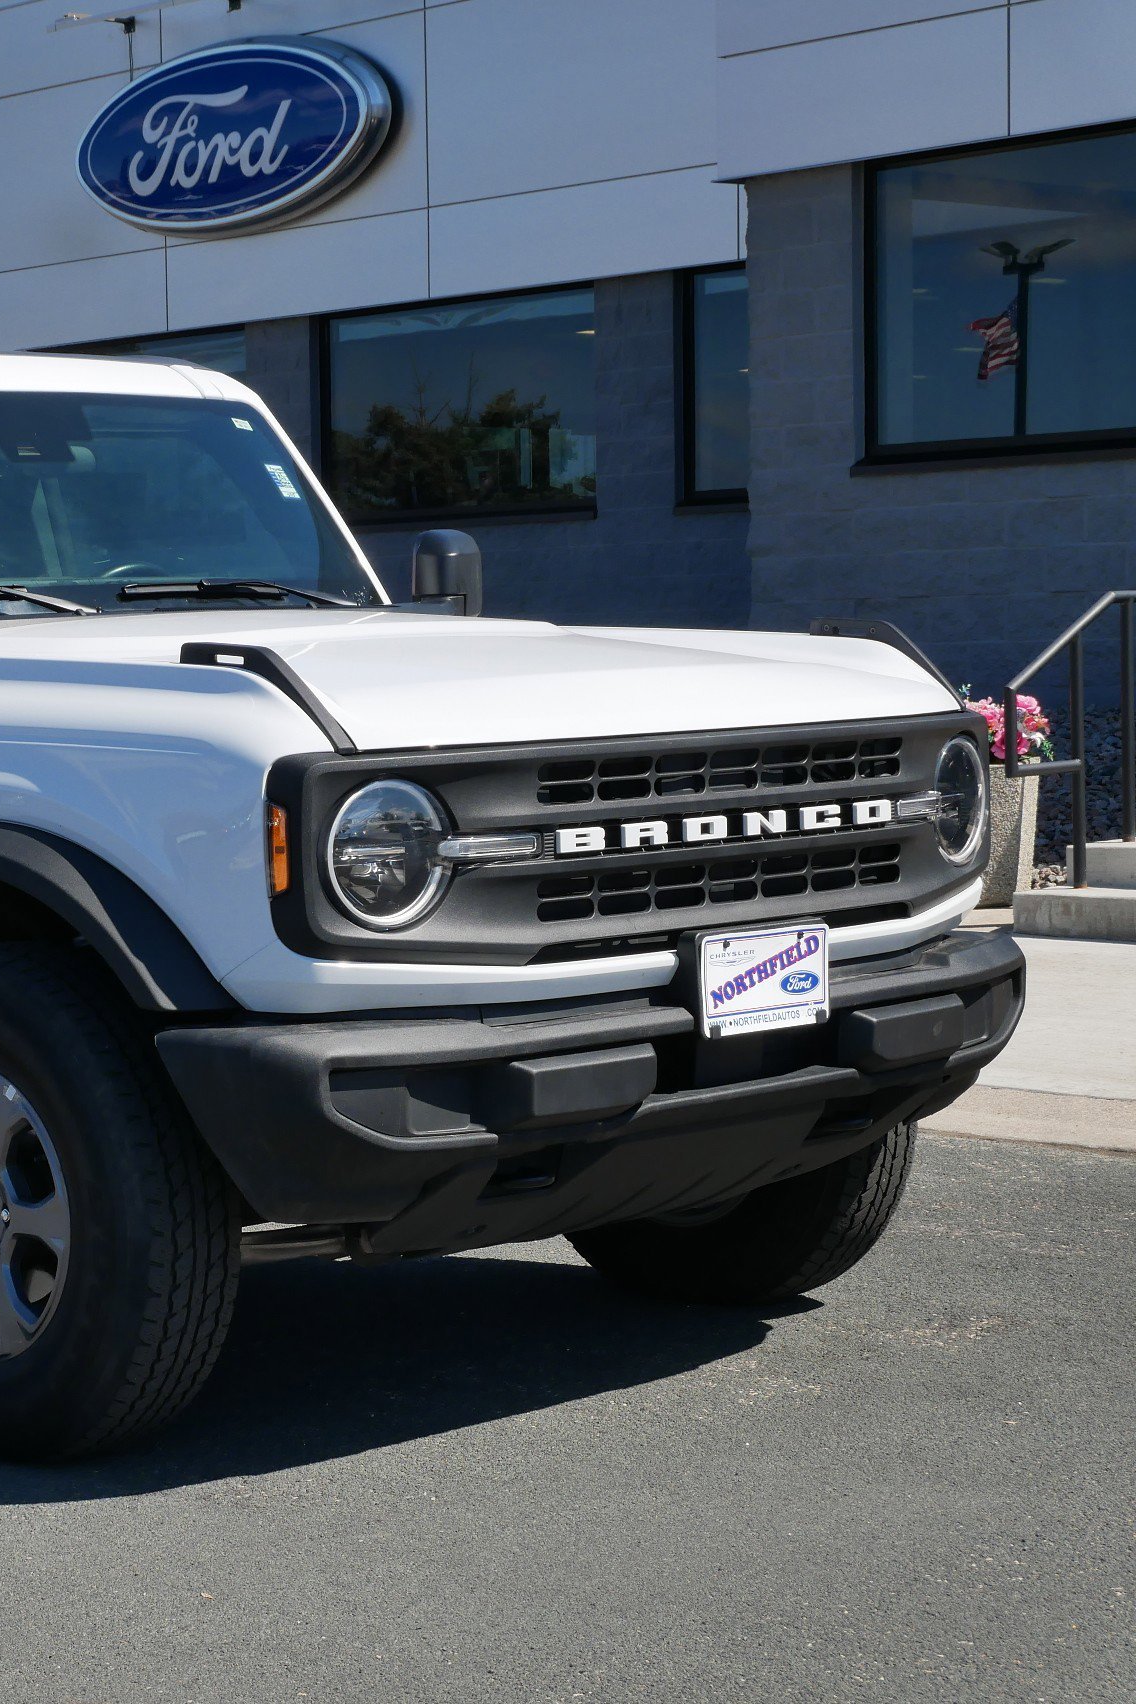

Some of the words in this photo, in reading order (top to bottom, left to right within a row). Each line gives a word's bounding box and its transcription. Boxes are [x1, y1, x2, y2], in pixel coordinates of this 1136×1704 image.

[128, 84, 292, 197] Ford
[555, 799, 892, 854] BRONCO
[709, 949, 755, 960] CHRYSLER
[709, 934, 820, 1010] NORTHFIELD
[786, 973, 812, 991] Ford
